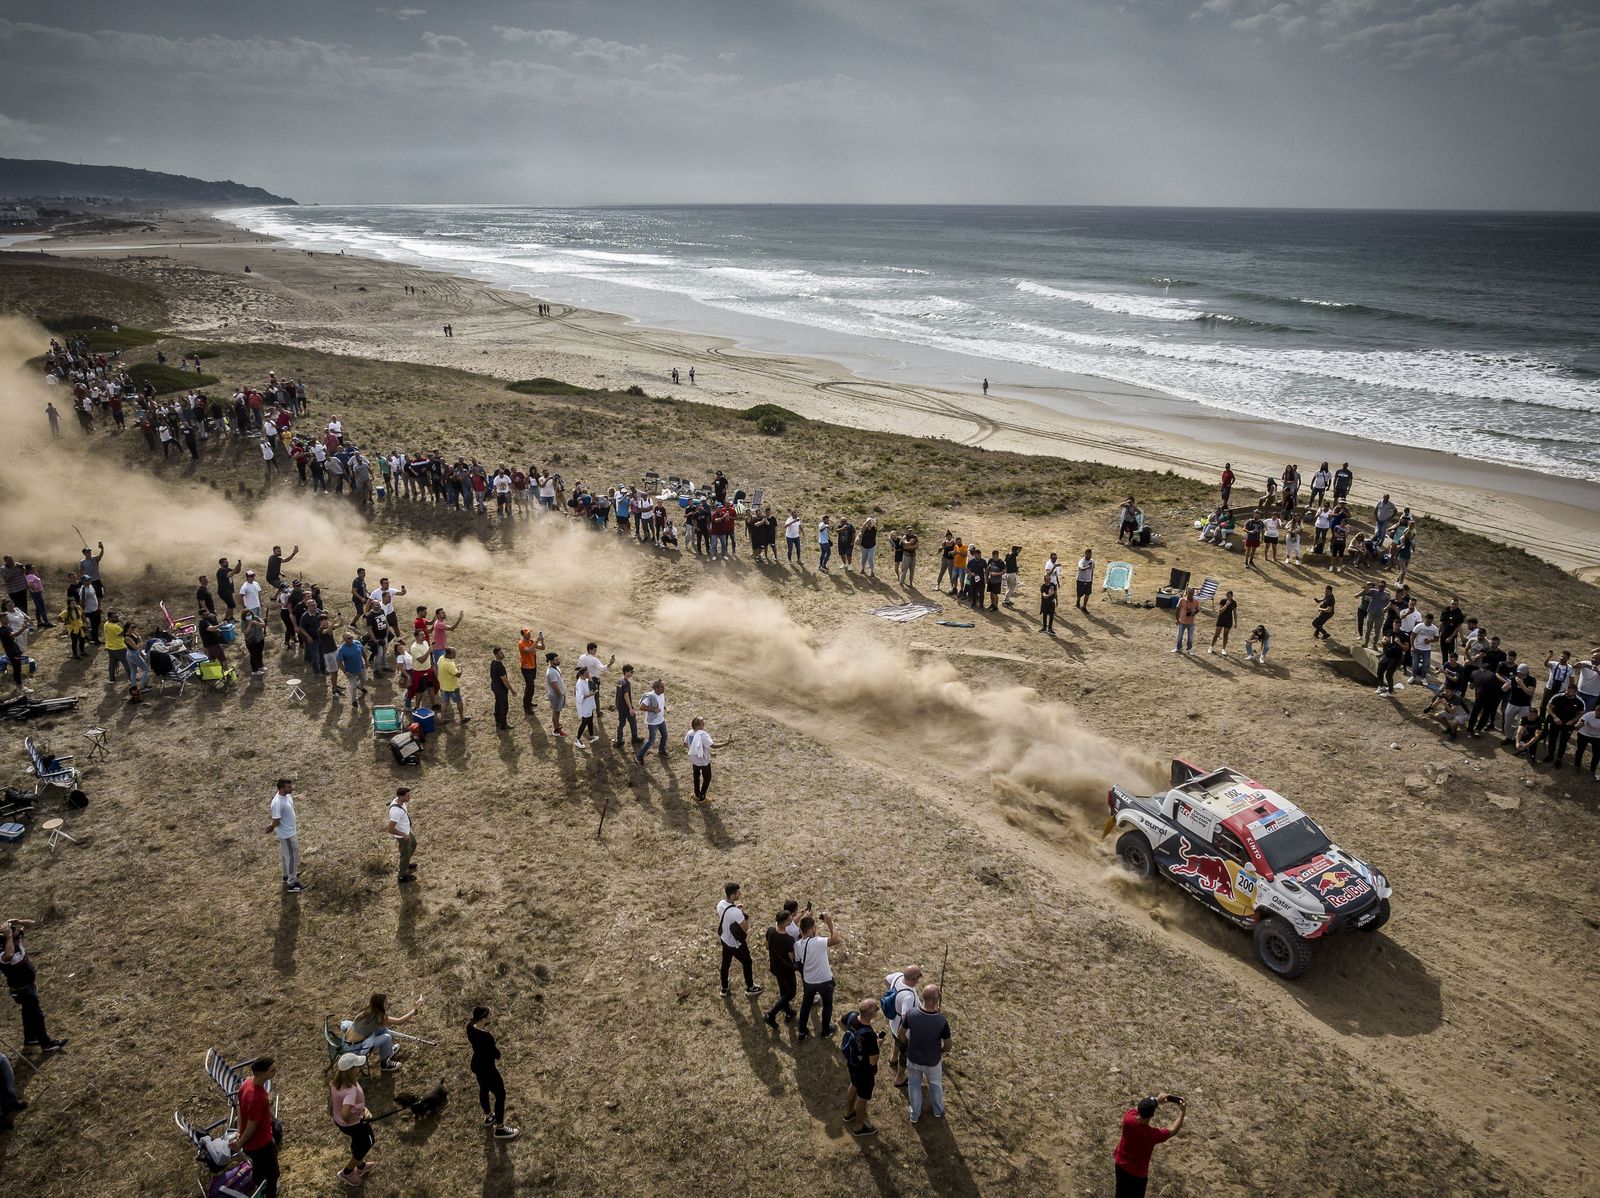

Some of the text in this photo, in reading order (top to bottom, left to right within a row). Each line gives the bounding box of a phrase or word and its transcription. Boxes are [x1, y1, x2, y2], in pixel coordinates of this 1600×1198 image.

[1113, 788, 1132, 805] HILUX
[1144, 820, 1168, 836] eurol
[1246, 837, 1262, 860] KINTO
[1238, 875, 1254, 893] 200
[1271, 895, 1292, 911] Qatar
